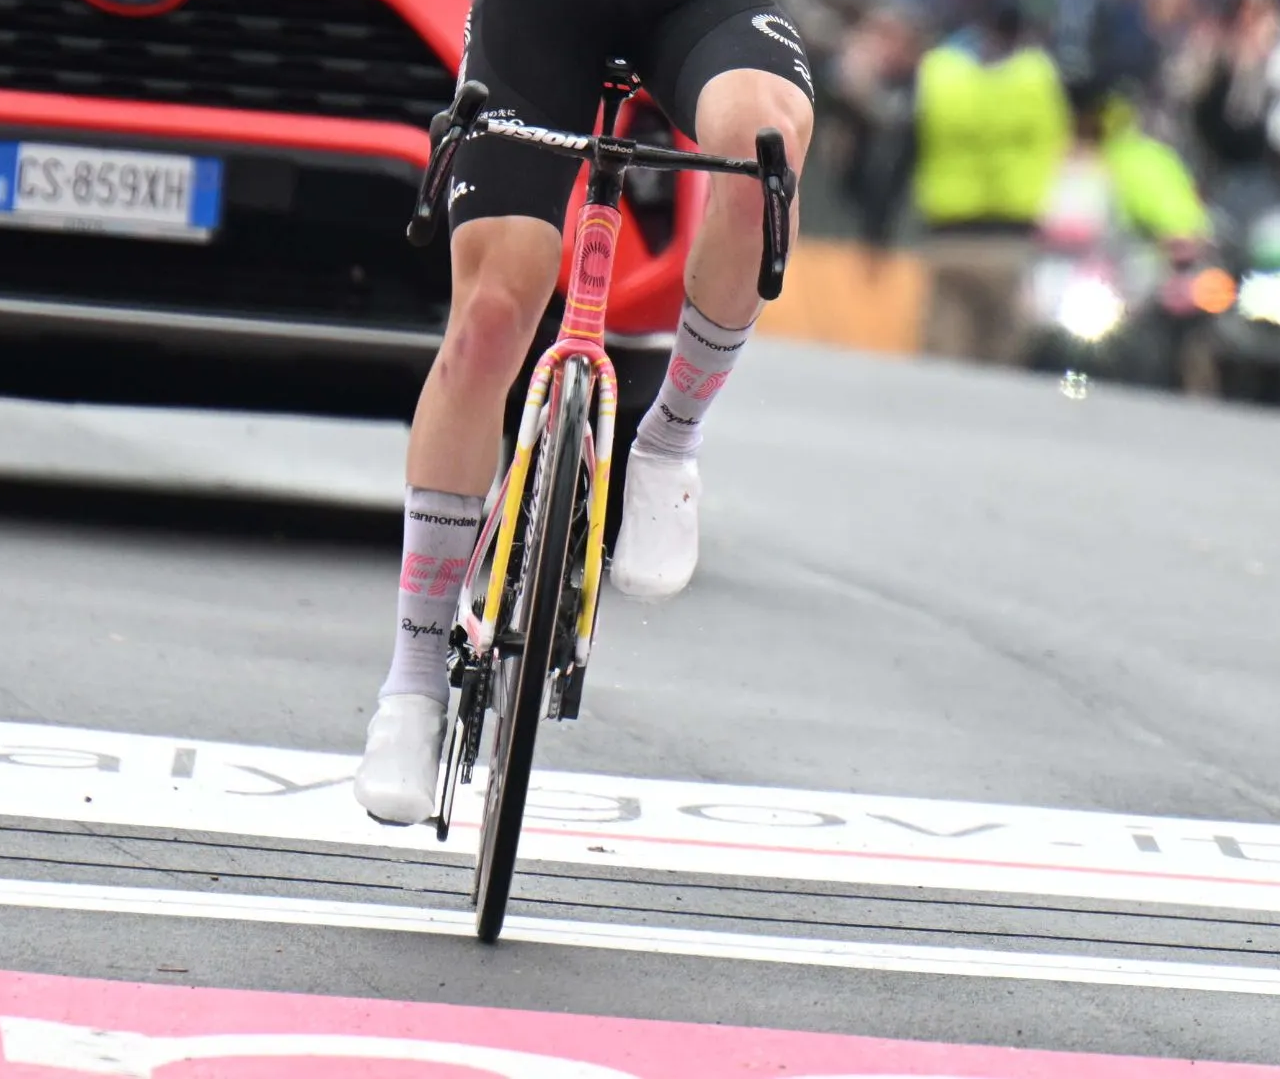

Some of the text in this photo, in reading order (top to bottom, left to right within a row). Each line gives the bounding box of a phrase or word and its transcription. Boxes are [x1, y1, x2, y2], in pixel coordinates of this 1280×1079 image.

[487, 121, 589, 151] vision
[409, 511, 477, 527] cannondale
[401, 618, 445, 638] Rapha
